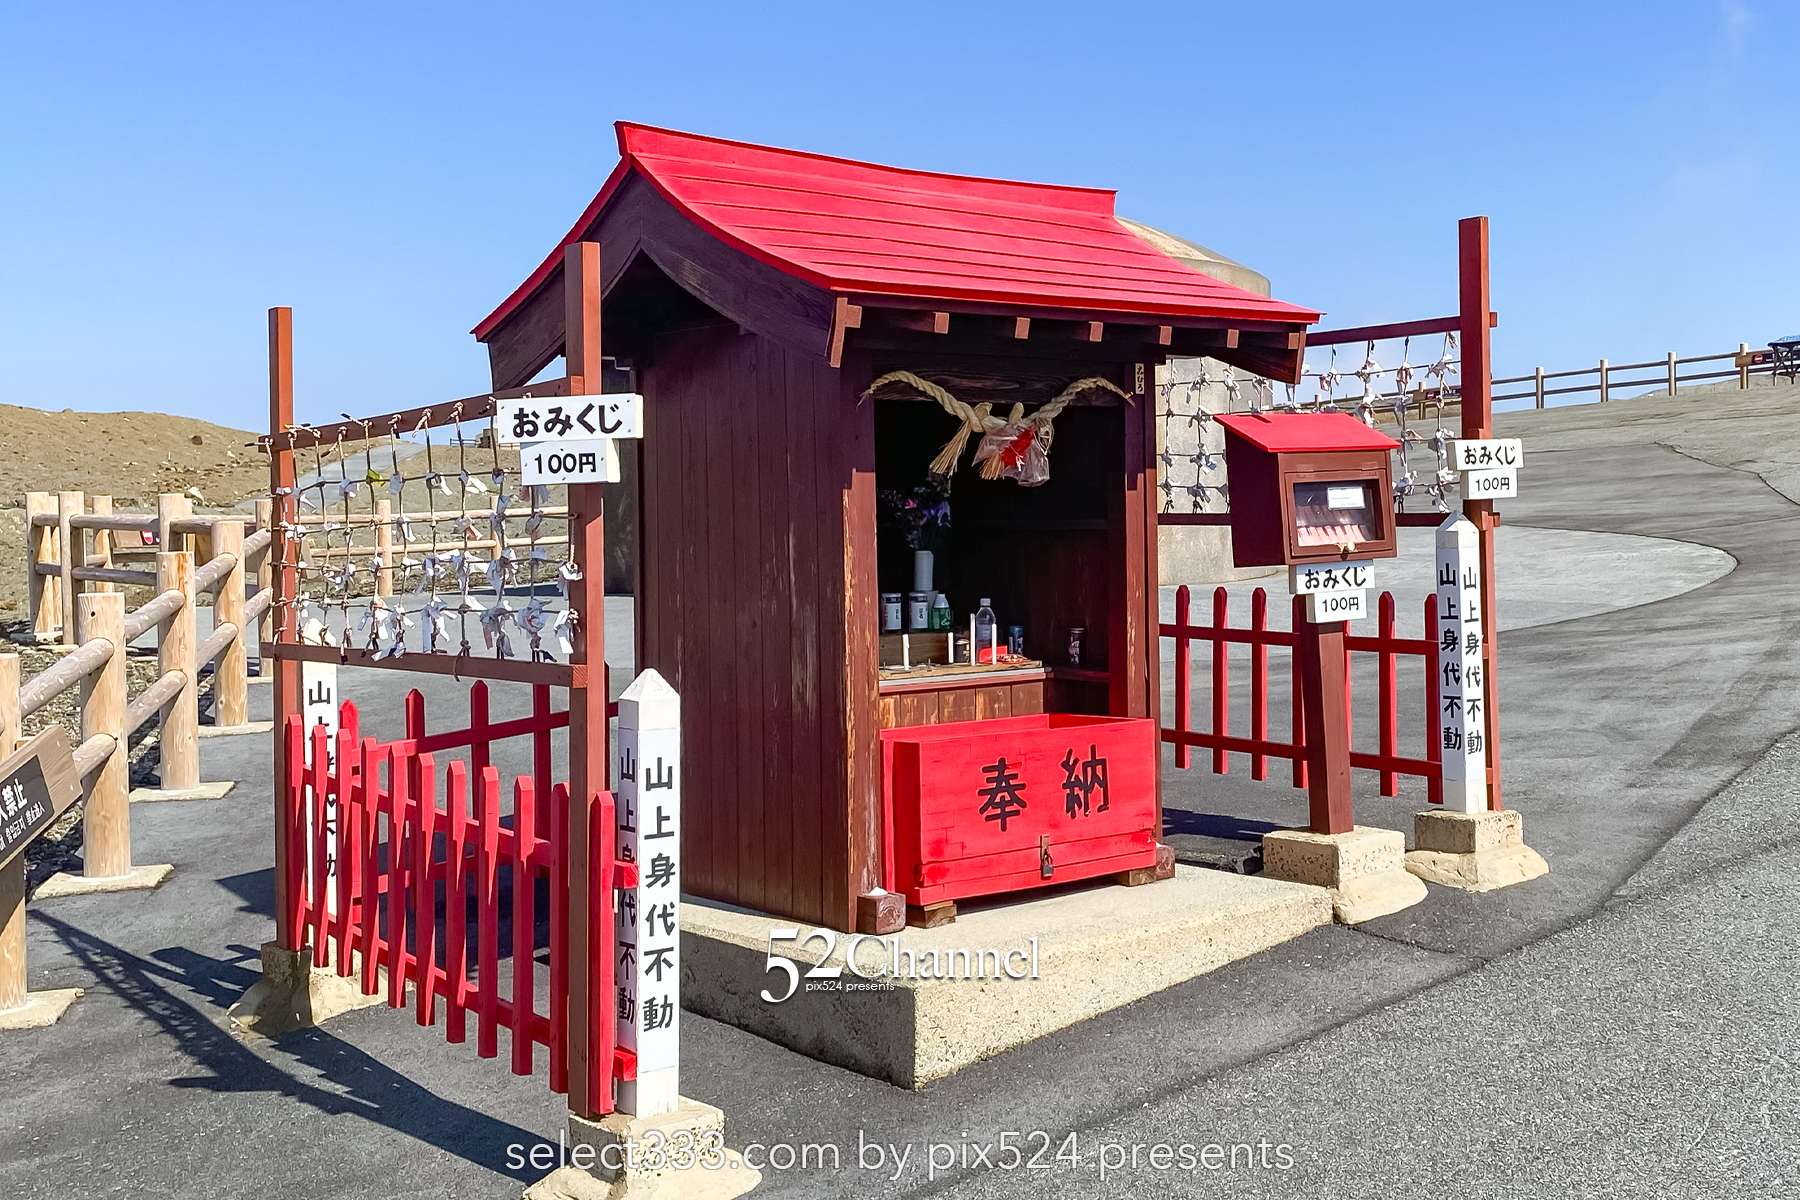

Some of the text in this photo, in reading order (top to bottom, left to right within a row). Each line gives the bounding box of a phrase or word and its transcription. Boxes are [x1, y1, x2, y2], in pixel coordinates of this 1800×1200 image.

[512, 402, 623, 438] おみくじ
[534, 452, 597, 474] 100円
[1464, 446, 1516, 466] おみくじ
[1475, 476, 1510, 491] 100円
[1305, 566, 1366, 589] おみくじ
[1322, 597, 1359, 612] 100円
[1439, 563, 1461, 751] 山上身代不動
[1463, 567, 1482, 754] 山上身代不動
[643, 757, 676, 1032] 山上身代不動
